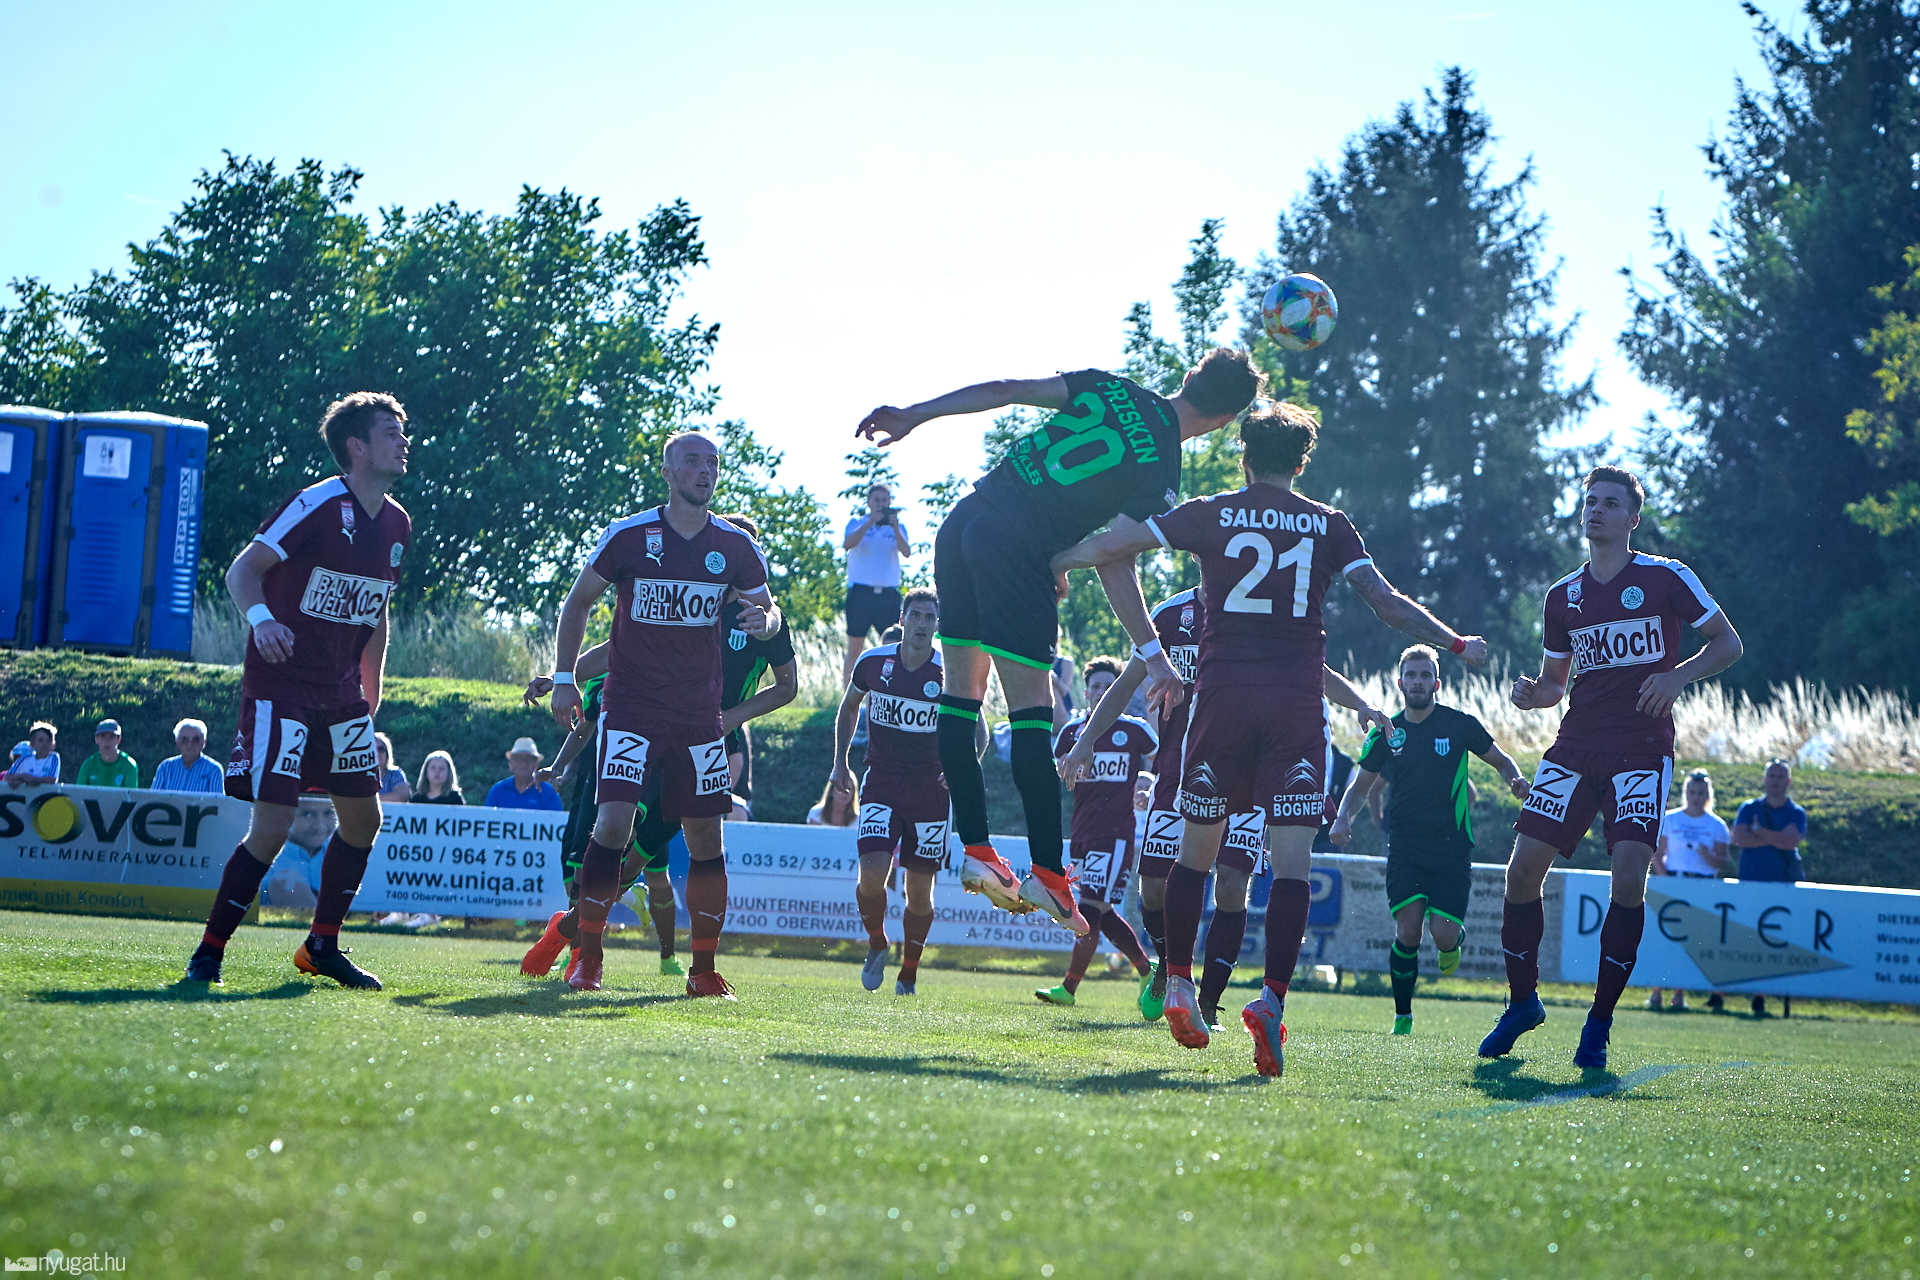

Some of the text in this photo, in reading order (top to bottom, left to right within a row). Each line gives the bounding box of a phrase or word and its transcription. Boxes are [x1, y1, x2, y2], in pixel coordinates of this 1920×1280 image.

[1096, 379, 1160, 464] PRISKIN
[1033, 390, 1127, 487] 20
[1219, 507, 1328, 536] SALOMON
[319, 574, 348, 599] BAU
[1223, 531, 1315, 618] 21
[640, 583, 668, 602] BAU
[638, 599, 671, 620] WELT
[1594, 621, 1661, 661] Koch
[889, 699, 938, 728] Koch
[338, 751, 376, 771] DACH
[606, 762, 643, 781] DACH
[1273, 801, 1323, 817] BOGNER
[1526, 792, 1566, 819] DACH
[1618, 800, 1656, 819] DACH
[860, 824, 887, 836] DACH
[1228, 832, 1262, 850] DACH
[386, 843, 434, 863] 0650
[451, 847, 487, 865] 964
[494, 849, 517, 867] 75
[522, 851, 546, 869] 03
[1146, 841, 1180, 856] DACH
[742, 852, 774, 868] 033
[810, 856, 843, 871] 324
[385, 870, 544, 895] www.uniqa.at
[411, 891, 458, 903] Oberwart
[726, 912, 768, 928] 7400
[776, 915, 864, 933] OBERWART
[966, 926, 1025, 943] A-7540
[1578, 894, 1834, 953] DETER
